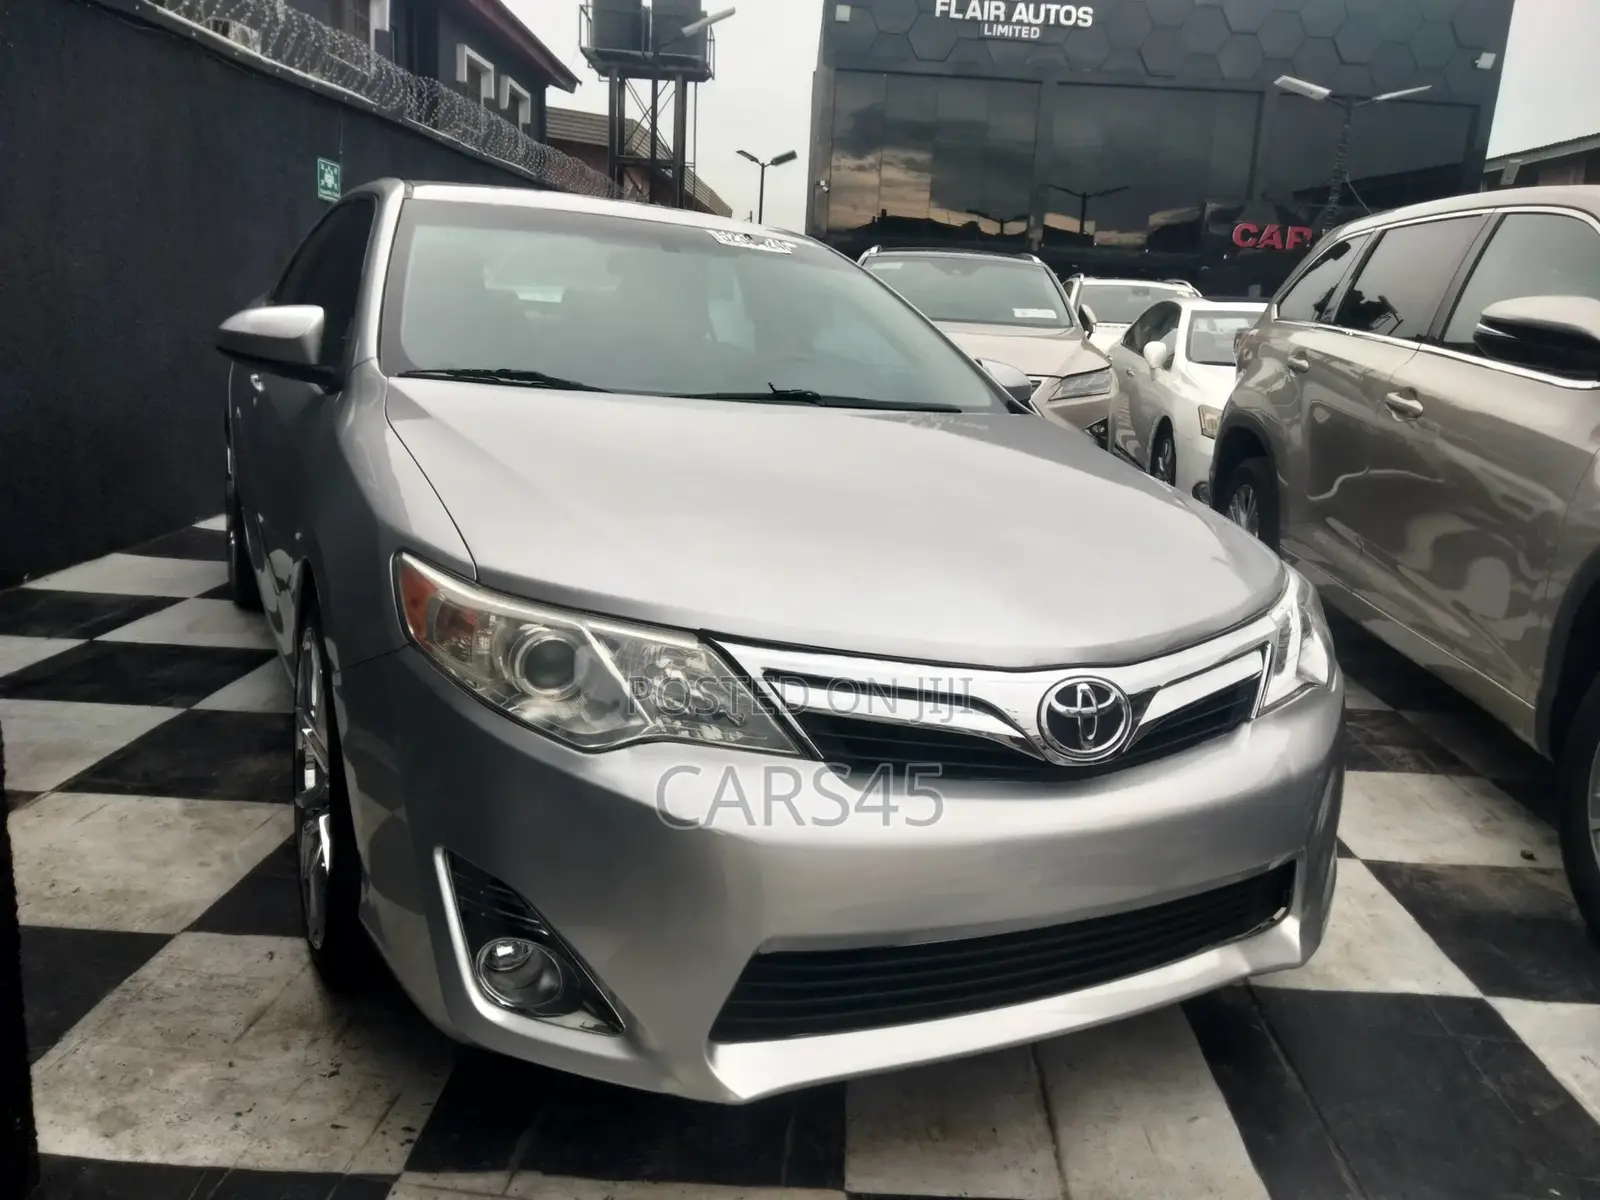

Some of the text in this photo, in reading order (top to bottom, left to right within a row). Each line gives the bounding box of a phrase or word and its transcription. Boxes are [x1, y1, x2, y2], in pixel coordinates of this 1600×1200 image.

[935, 0, 1094, 27] FLAIR AUTOS
[983, 23, 1040, 39] LIMITED
